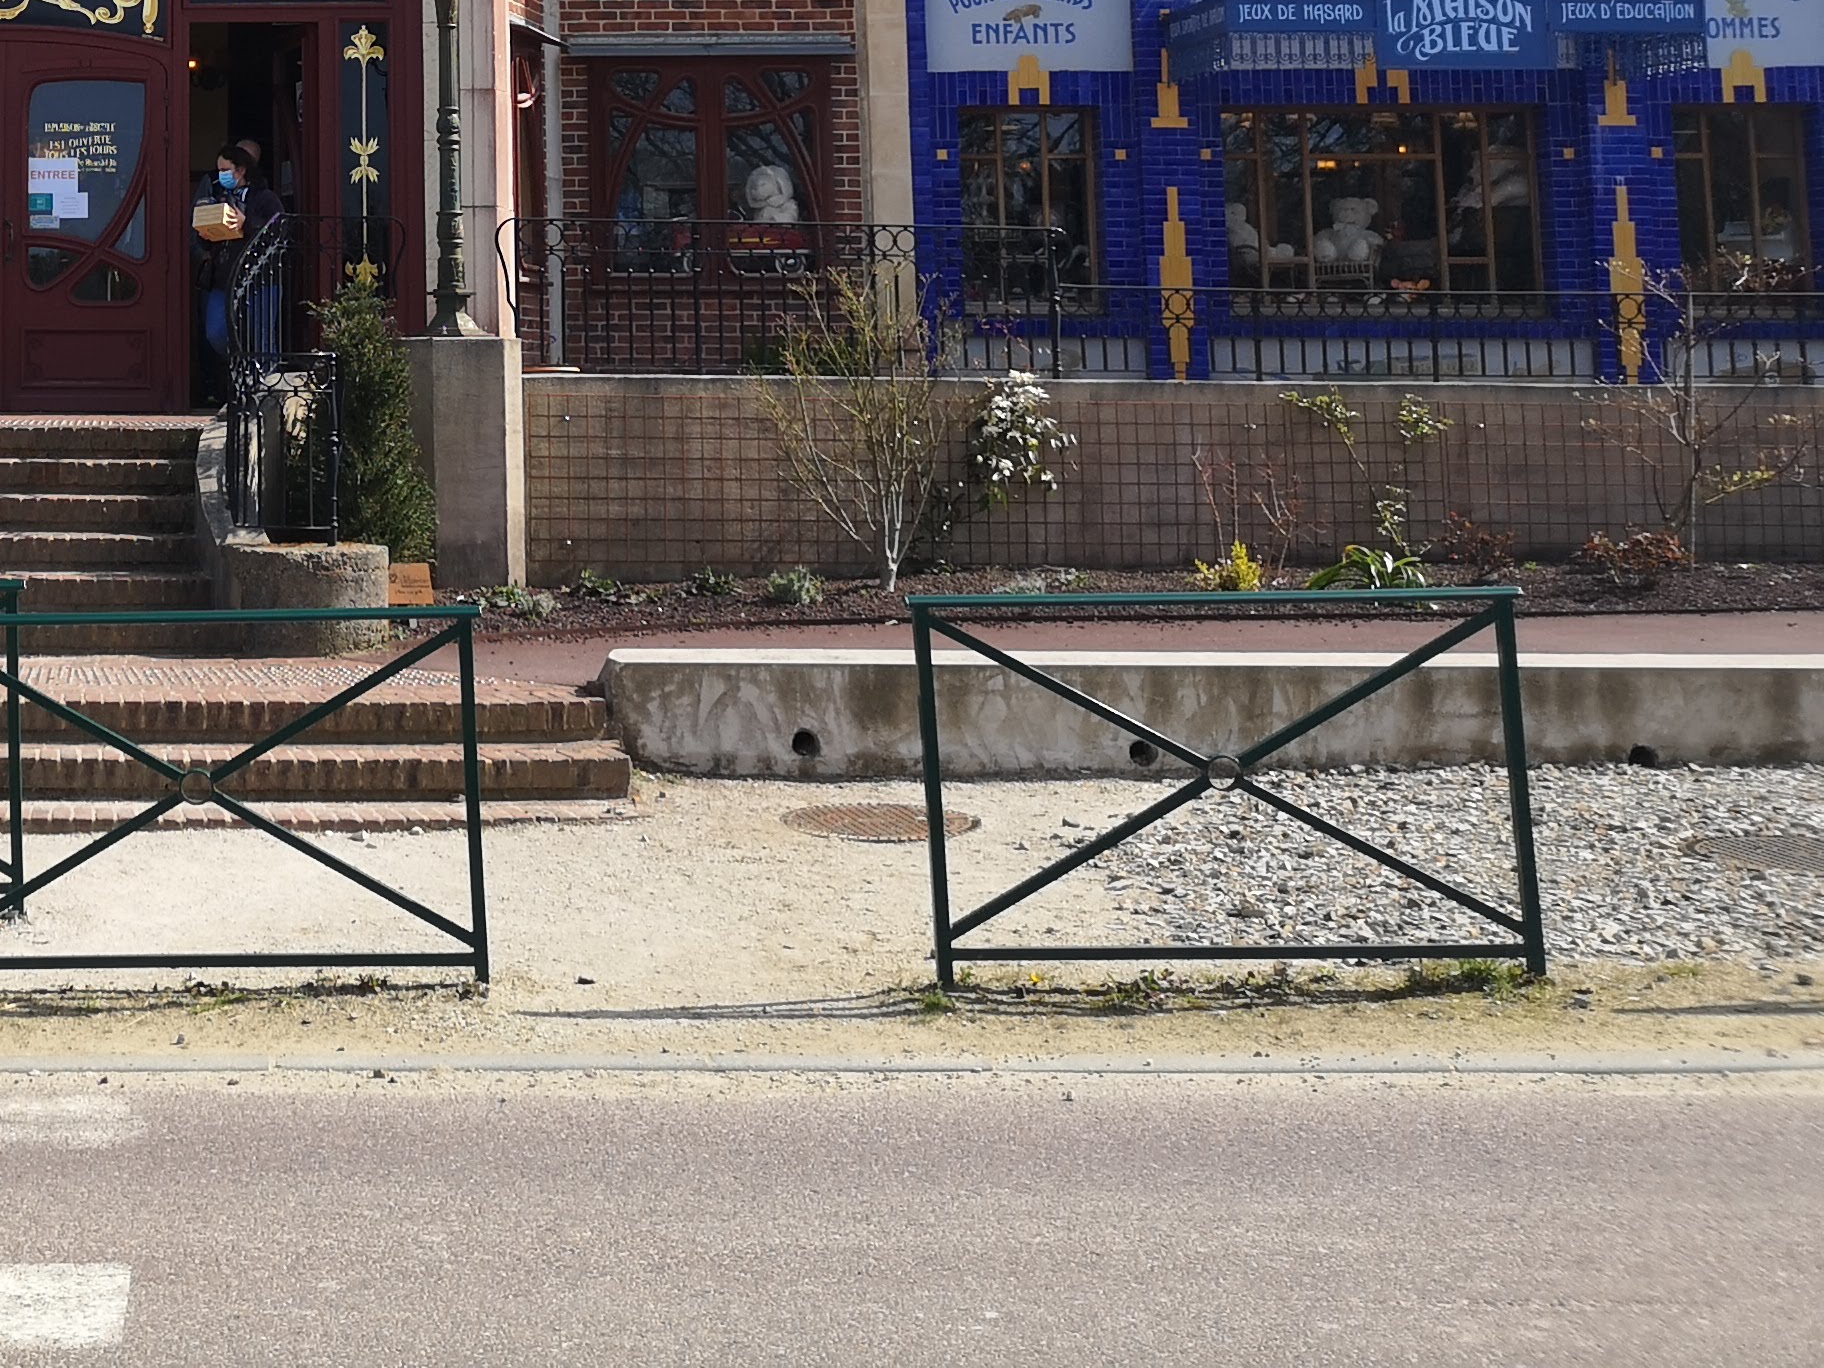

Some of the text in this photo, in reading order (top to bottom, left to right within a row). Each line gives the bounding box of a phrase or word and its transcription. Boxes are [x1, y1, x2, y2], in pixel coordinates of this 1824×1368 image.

[1239, 4, 1273, 23] JEUX
[1278, 4, 1297, 20] DE
[1304, 3, 1363, 25] HASARD
[1561, 0, 1695, 23] JEUX D'EDUCATION
[971, 23, 1077, 45] ENFANTS
[1707, 17, 1781, 39] OMMES
[1415, 21, 1520, 61] BLEUE
[69, 134, 112, 148] OUVERTE
[31, 171, 76, 180] ENTREE
